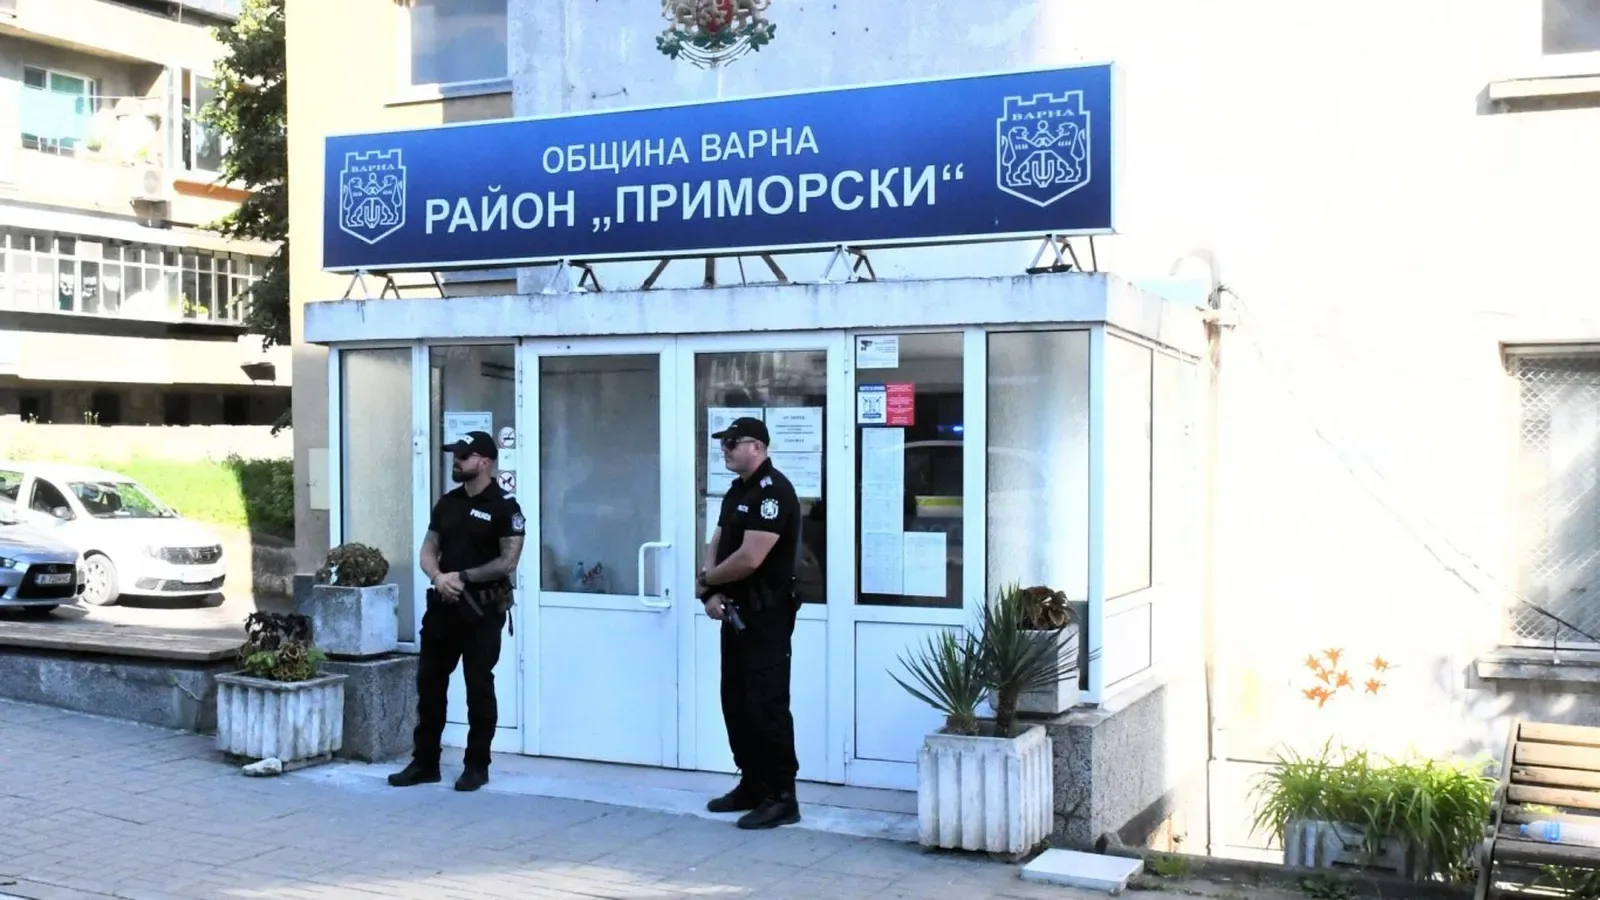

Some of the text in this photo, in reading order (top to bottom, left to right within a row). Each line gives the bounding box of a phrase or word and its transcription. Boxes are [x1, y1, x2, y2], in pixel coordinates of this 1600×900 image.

[1012, 109, 1075, 121] ВАРНА
[542, 125, 820, 174] ОБЩИНА ВАРНА
[351, 163, 395, 173] ВАРНА
[425, 184, 575, 234] РАЙОН
